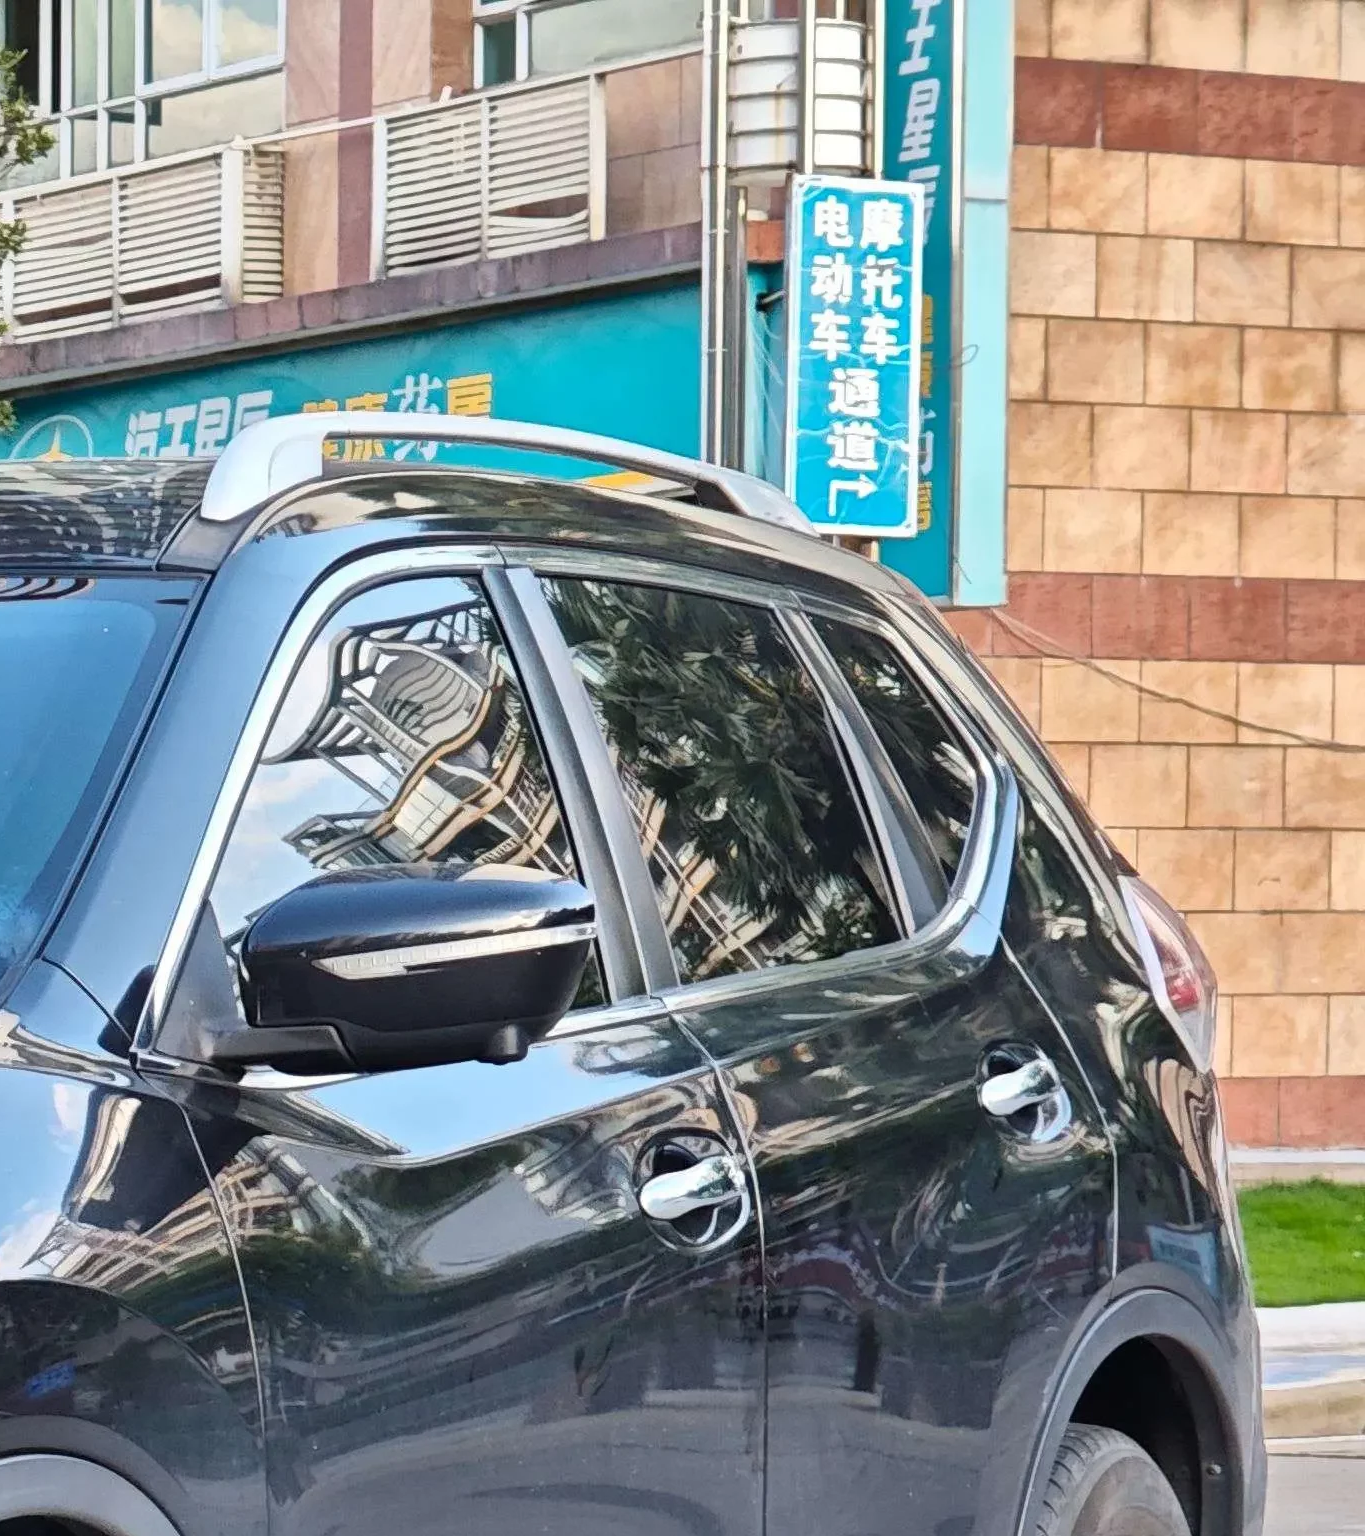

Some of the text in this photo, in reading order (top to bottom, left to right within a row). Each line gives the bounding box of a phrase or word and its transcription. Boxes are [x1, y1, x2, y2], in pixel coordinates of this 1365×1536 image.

[809, 194, 854, 362] 电动车
[860, 198, 904, 365] 摩托车
[826, 367, 881, 471] 通道
